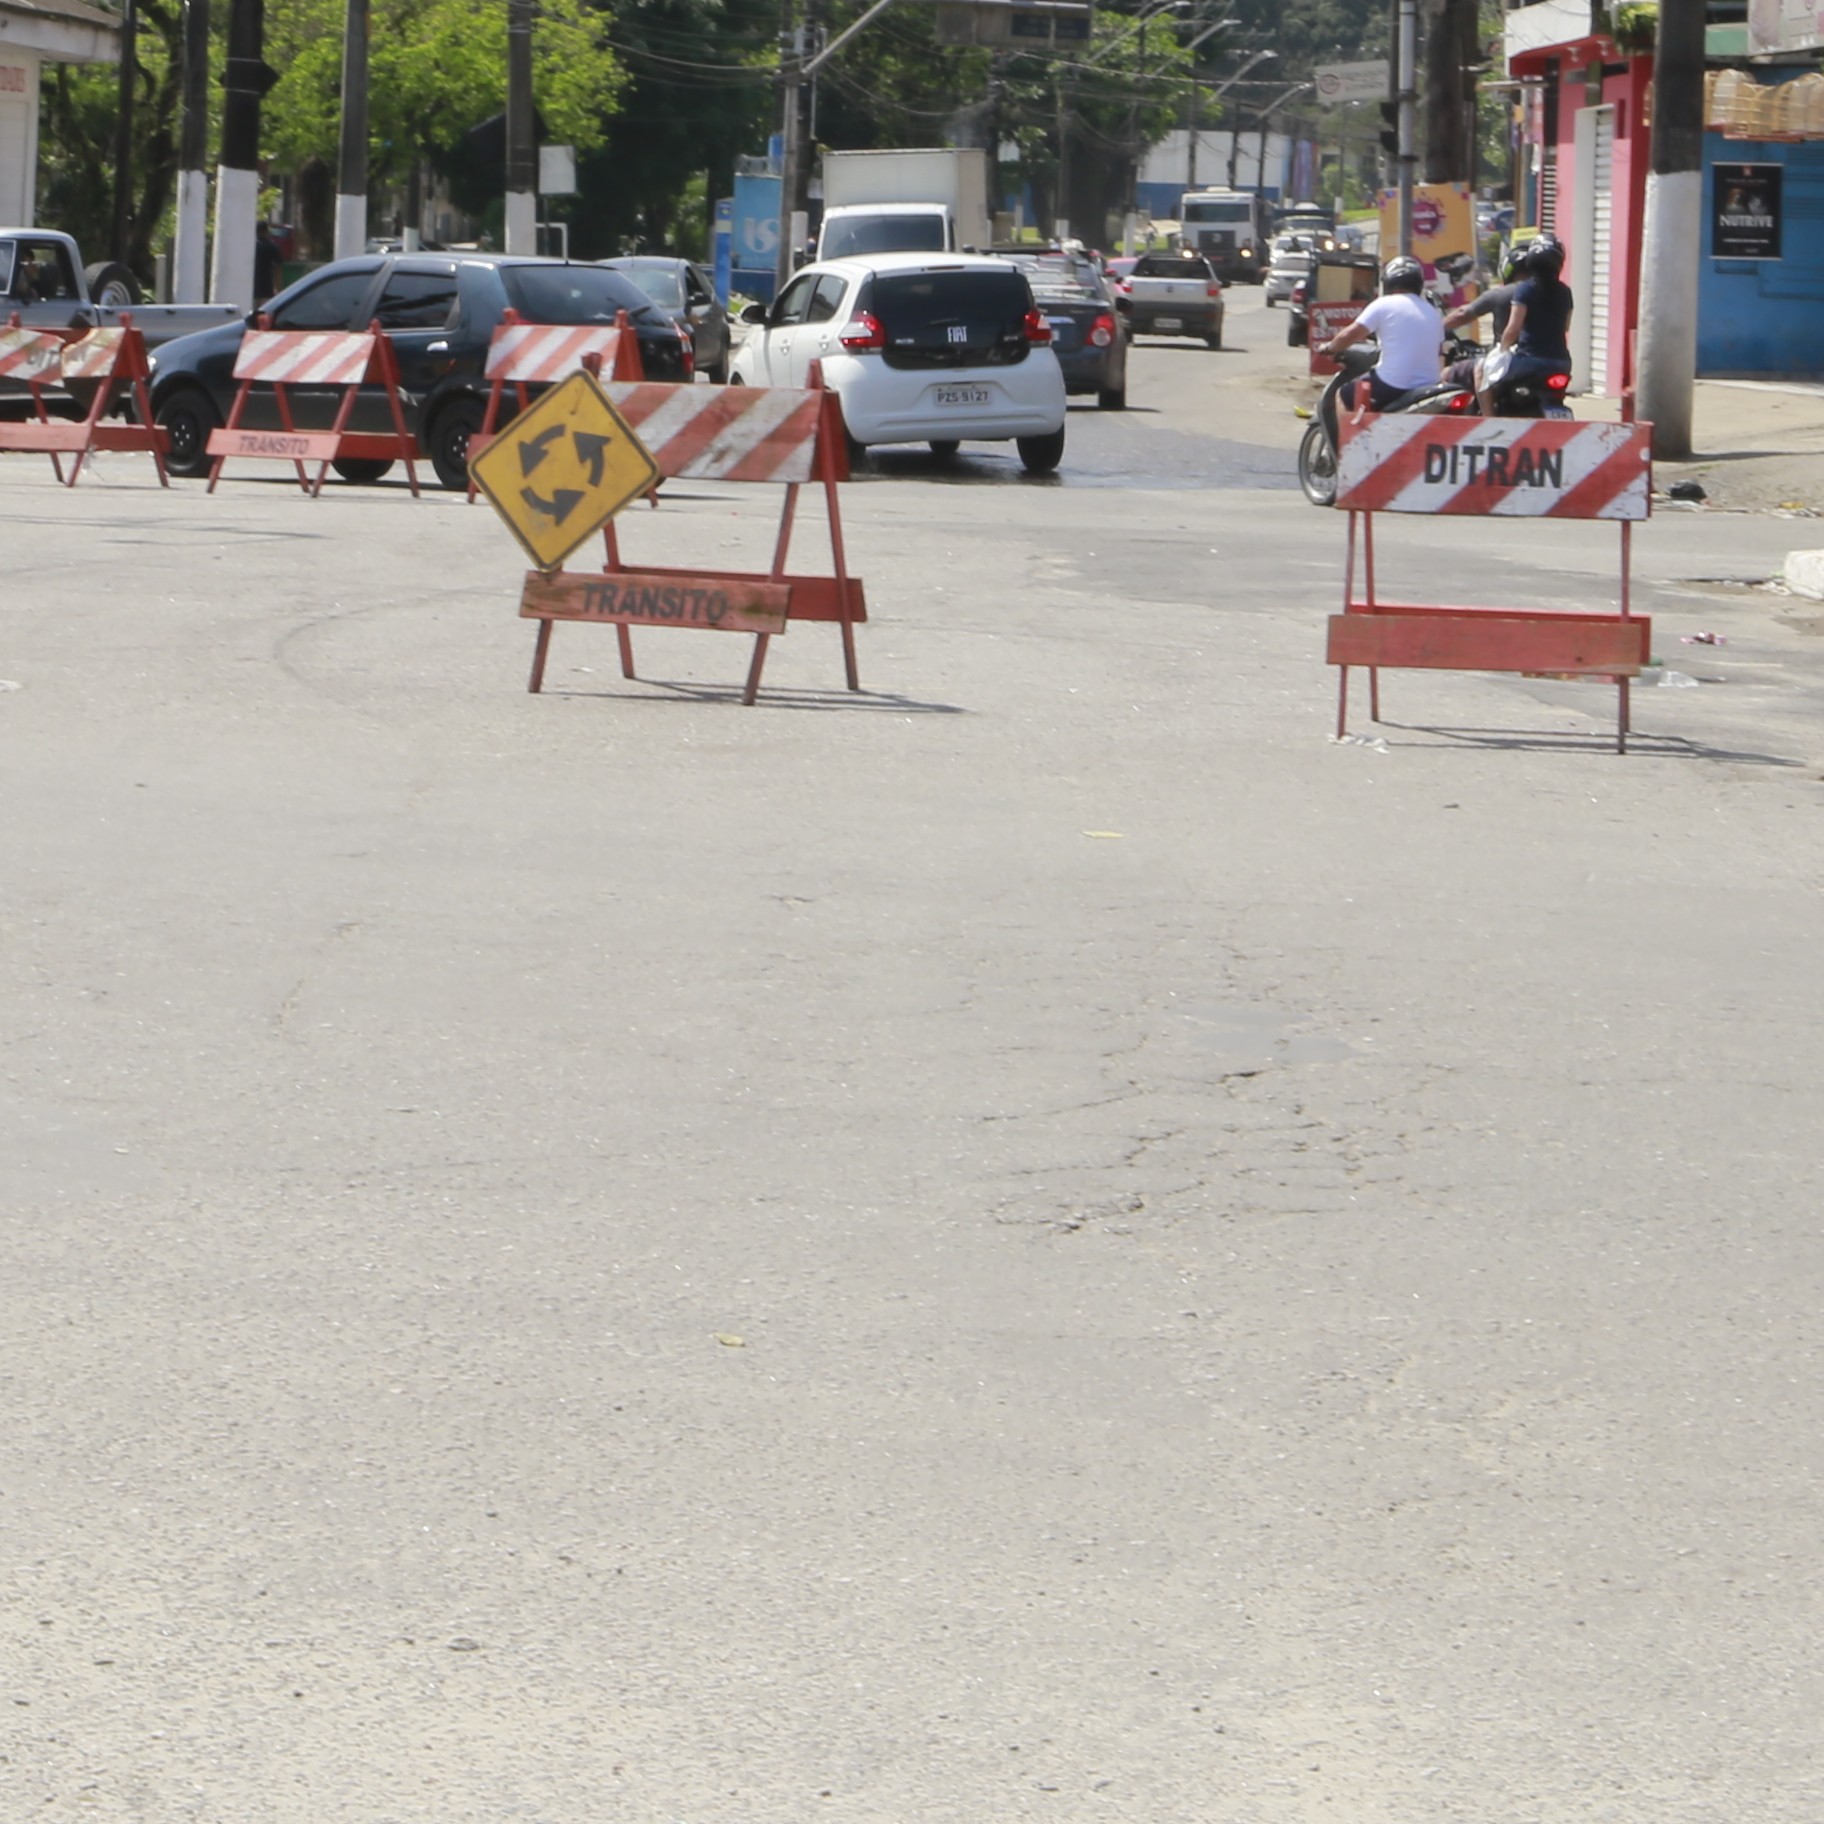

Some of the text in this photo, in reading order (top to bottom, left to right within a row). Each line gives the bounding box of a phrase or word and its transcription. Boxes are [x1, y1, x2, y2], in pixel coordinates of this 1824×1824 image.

[1719, 214, 1774, 228] NUTRIVE
[947, 326, 968, 343] FIAT
[1423, 443, 1564, 489] DITRAN
